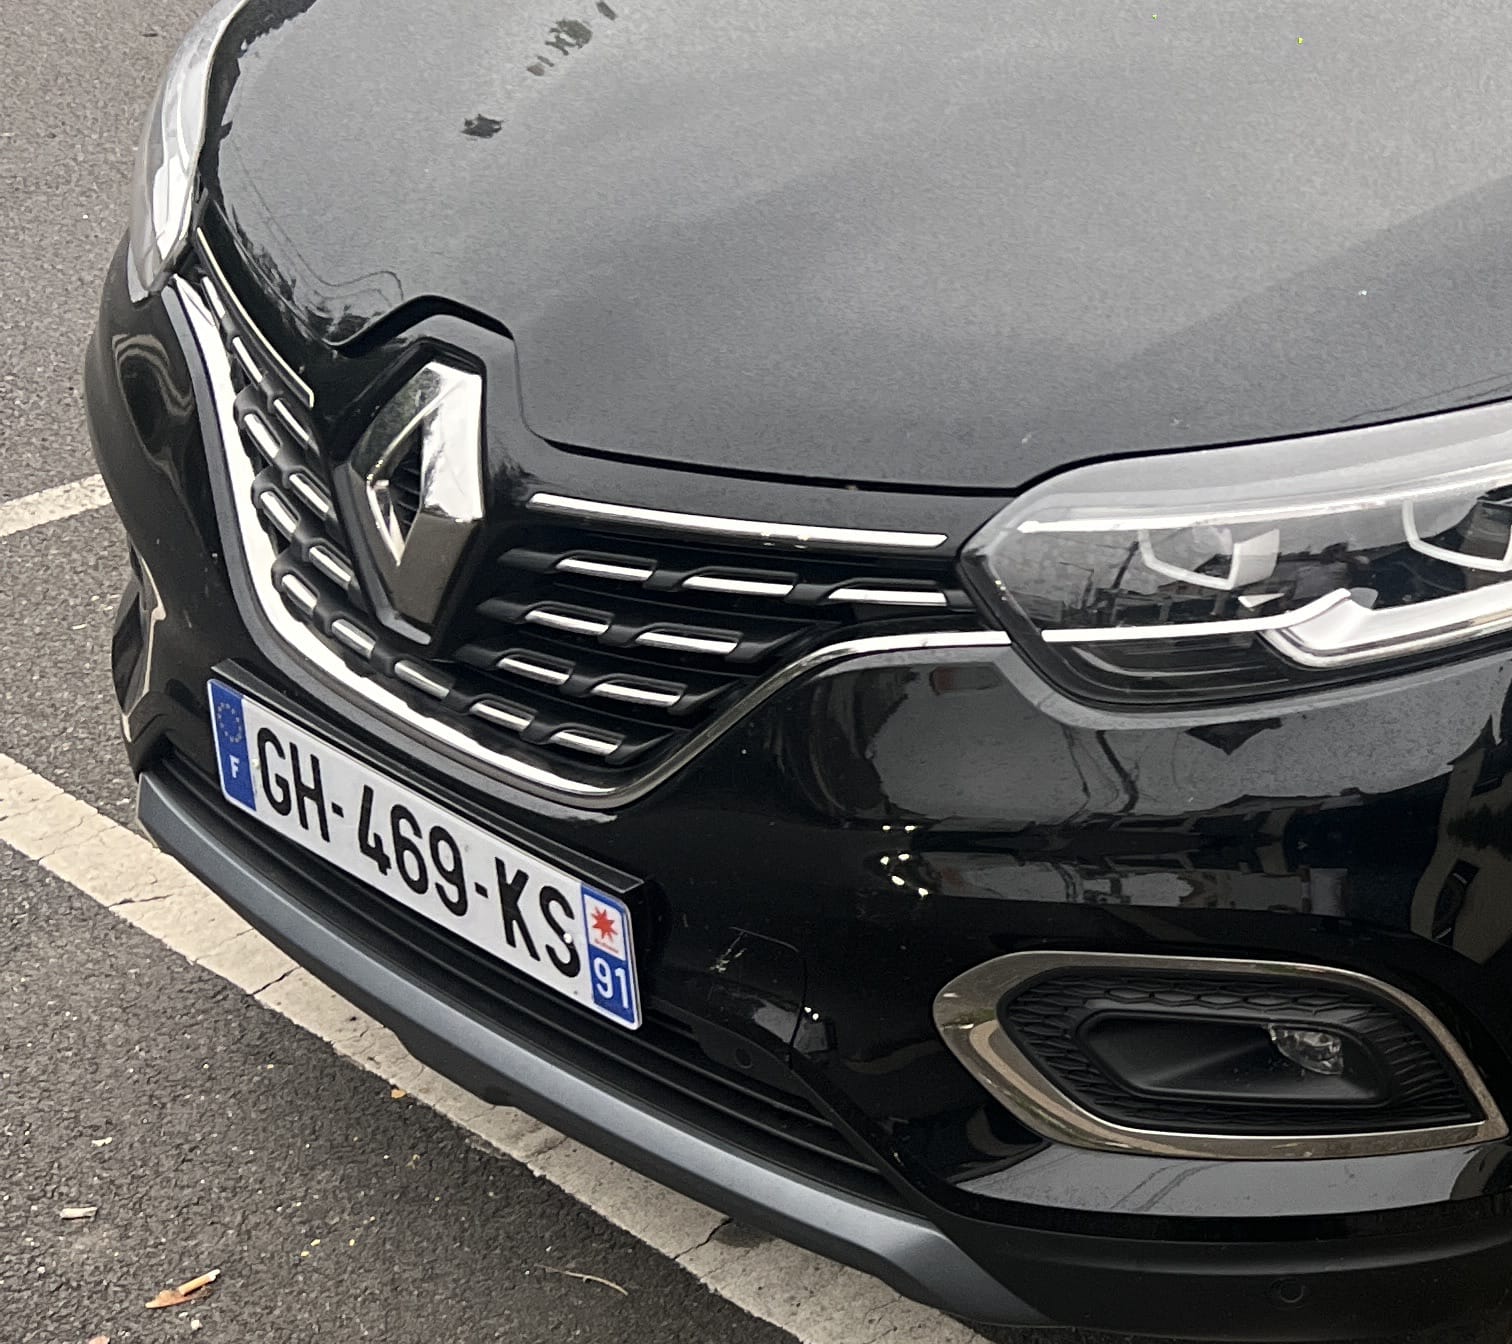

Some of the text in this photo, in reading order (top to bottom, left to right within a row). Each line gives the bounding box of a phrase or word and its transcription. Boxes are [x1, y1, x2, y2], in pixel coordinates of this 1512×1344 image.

[229, 754, 241, 779] F
[257, 727, 581, 978] GH-469-KS
[593, 957, 629, 1009] 91
